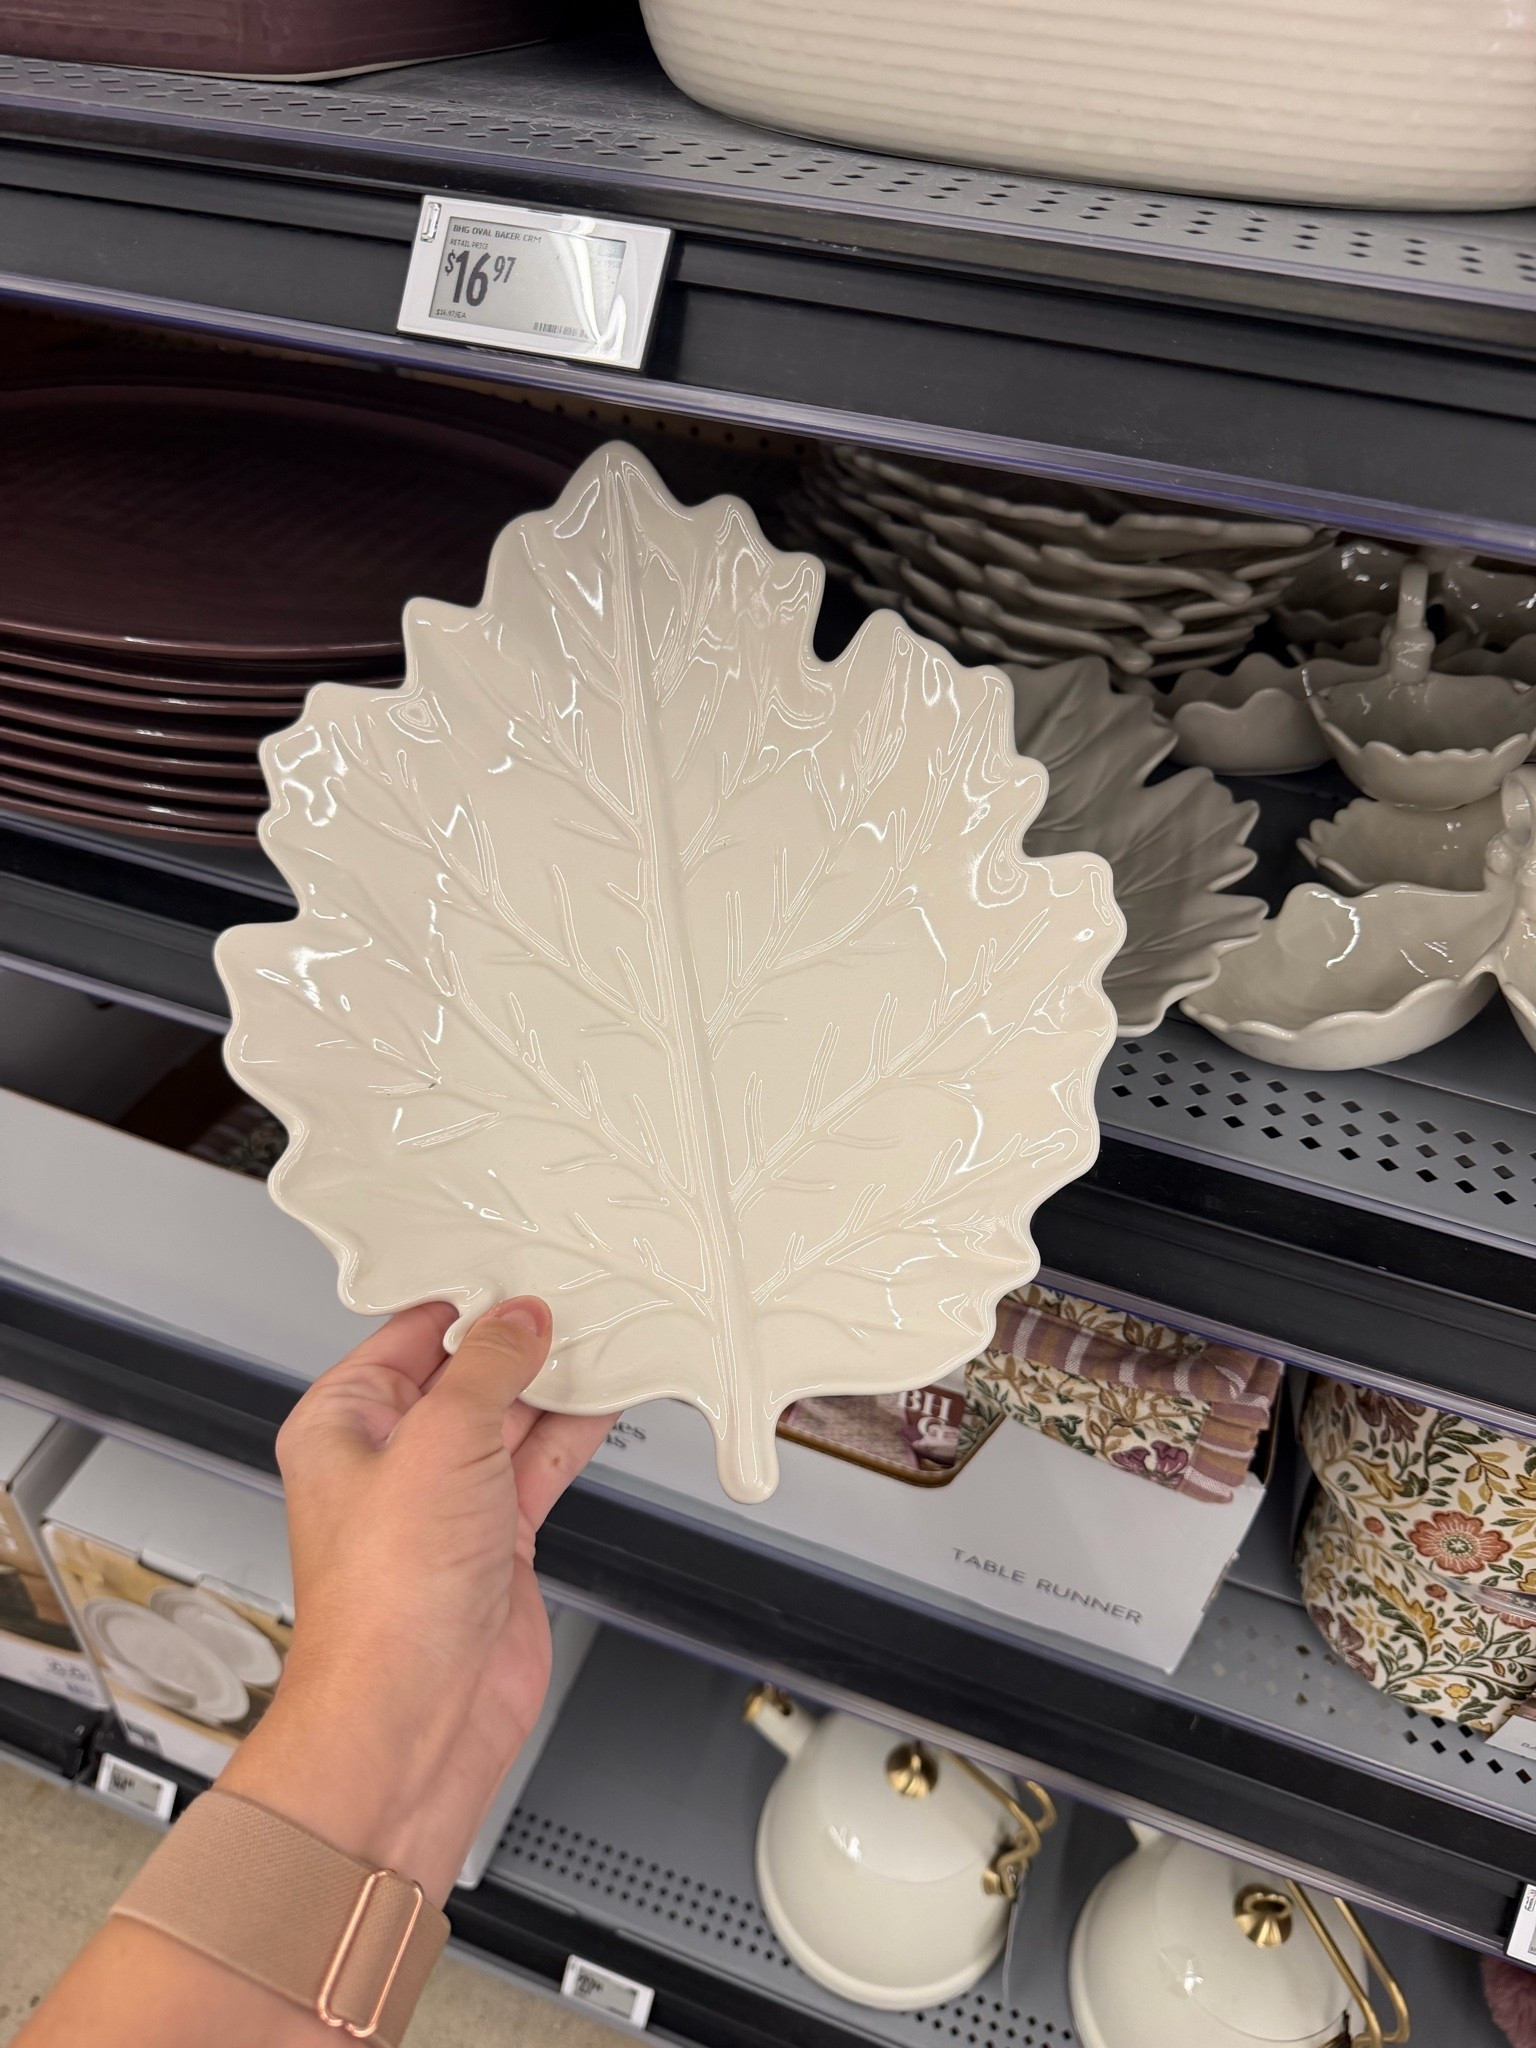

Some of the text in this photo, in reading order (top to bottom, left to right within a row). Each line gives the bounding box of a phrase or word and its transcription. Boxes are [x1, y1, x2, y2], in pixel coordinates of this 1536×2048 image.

[450, 238, 489, 250] RETAIL PRICE
[453, 224, 542, 244] BHG OVAL BAKER CRM
[952, 1547, 1144, 1626] TABLE RUNNER
